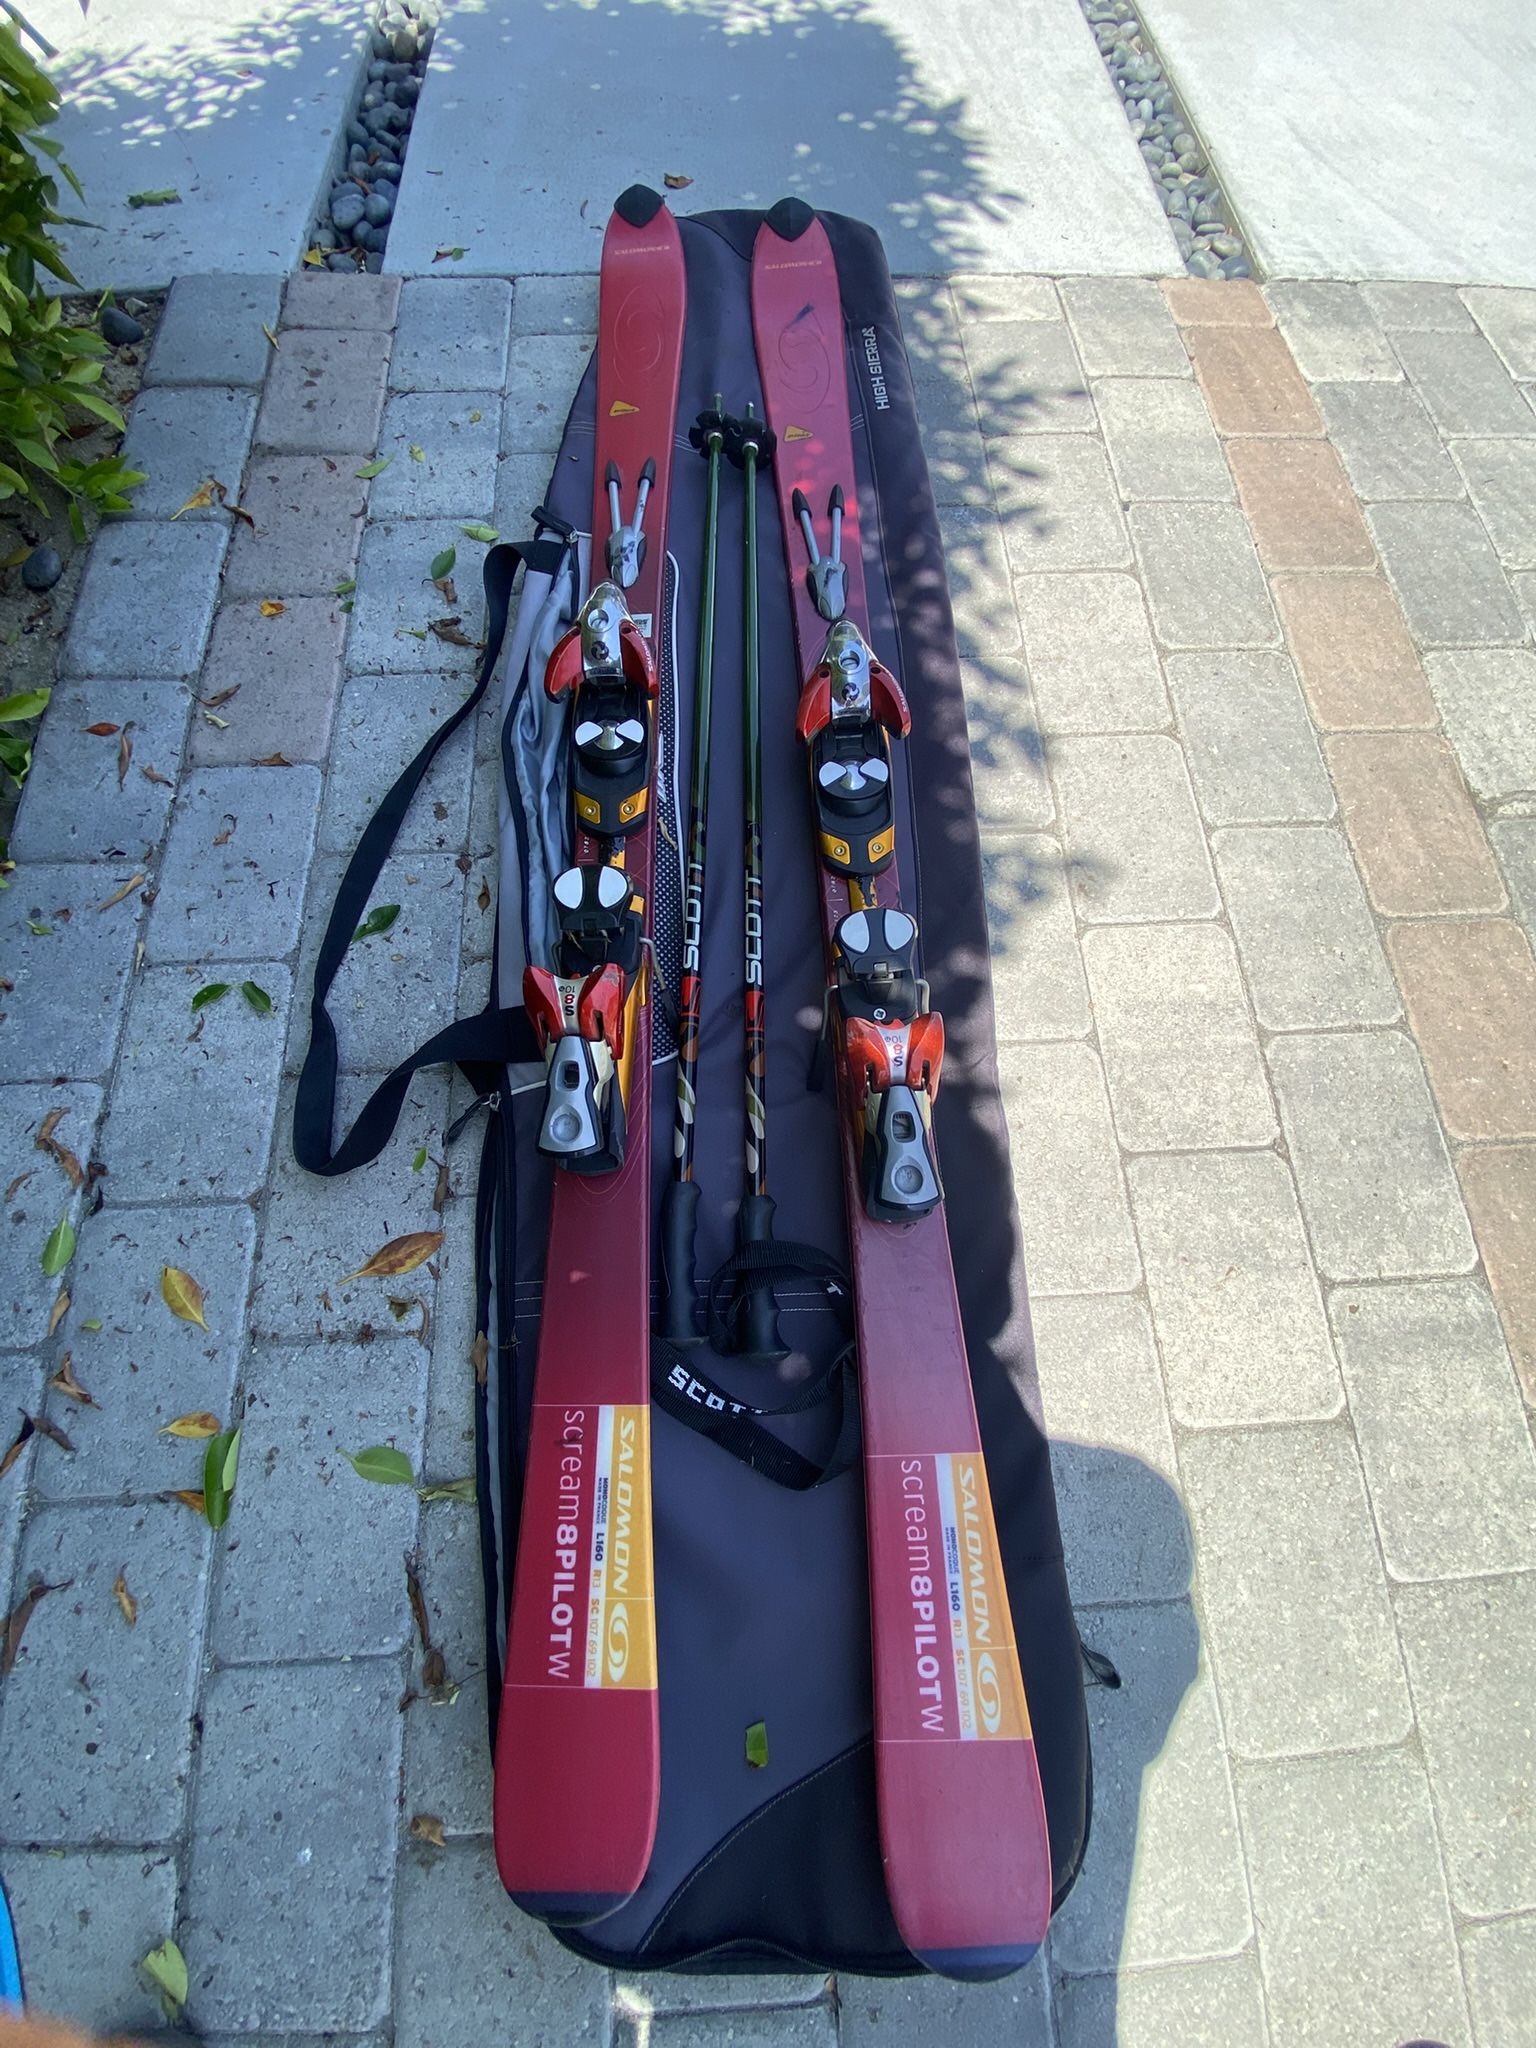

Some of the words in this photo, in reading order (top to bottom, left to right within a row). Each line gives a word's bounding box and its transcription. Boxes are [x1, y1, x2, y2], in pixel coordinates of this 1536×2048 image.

[863, 326, 882, 374] SIERRA
[871, 376, 890, 410] HIGH
[682, 856, 703, 971] SCOTT
[745, 869, 762, 986] SCOTT
[600, 1477, 609, 1524] MONOCOQUE
[613, 1416, 635, 1594] SALOMON
[595, 1532, 605, 1562] L160
[949, 1527, 960, 1574] MONOCOQUE
[960, 1464, 991, 1643] SALOMON
[592, 1569, 602, 1588] R13
[950, 1582, 961, 1611] L160
[591, 1598, 600, 1614] SC
[589, 1618, 599, 1635] 107
[956, 1648, 965, 1665] SC
